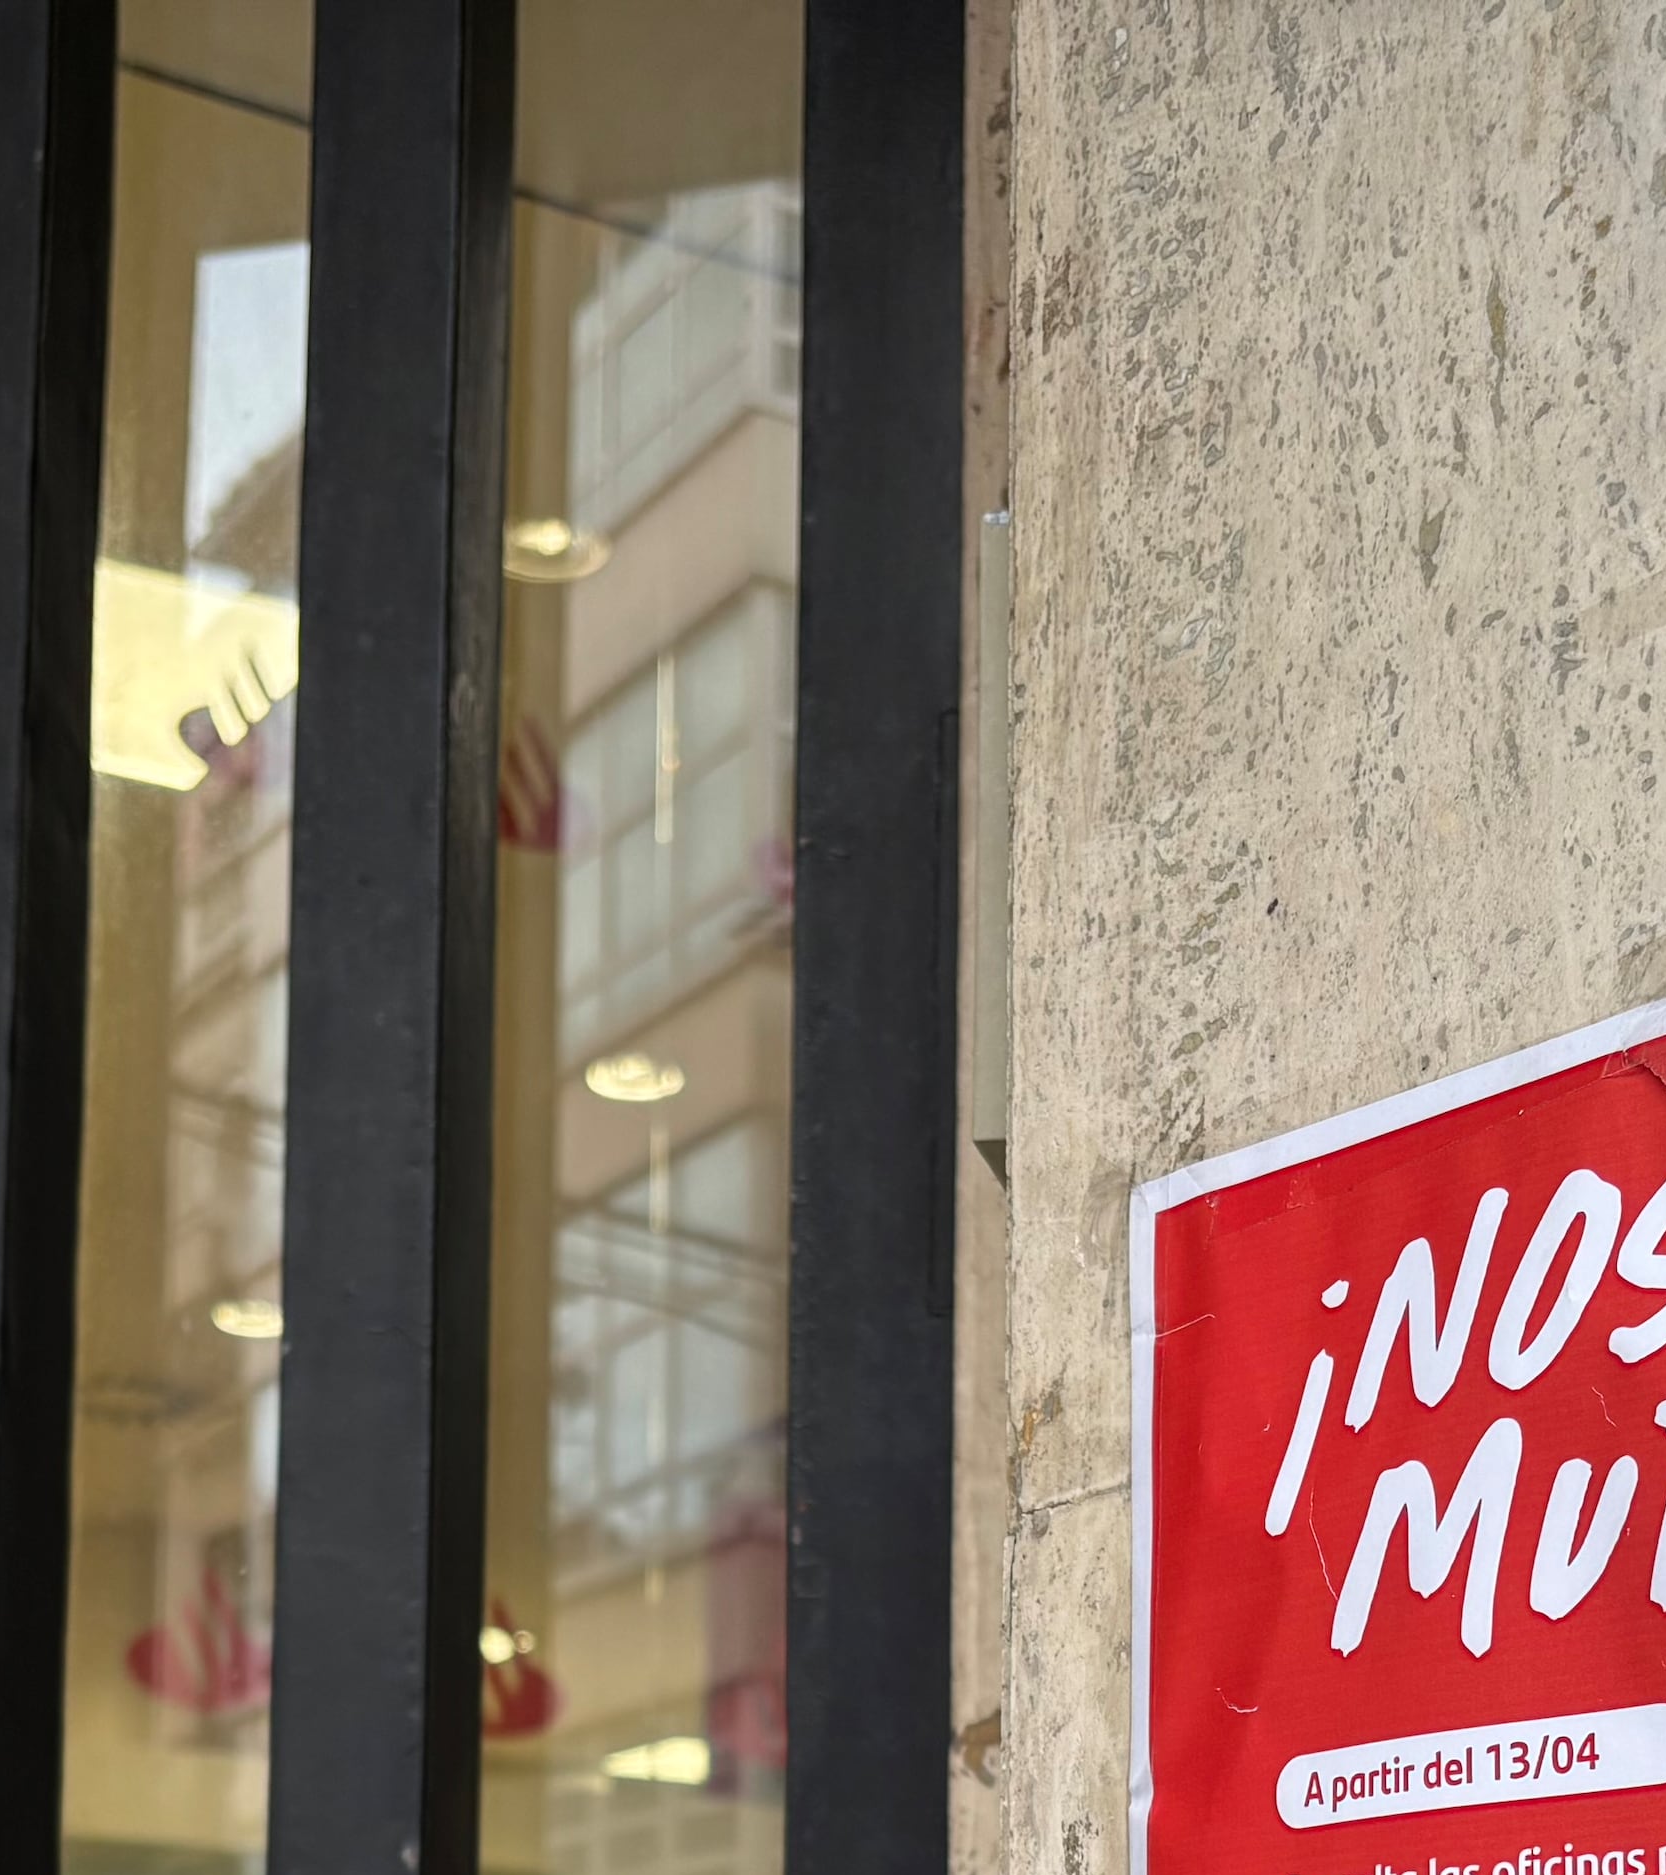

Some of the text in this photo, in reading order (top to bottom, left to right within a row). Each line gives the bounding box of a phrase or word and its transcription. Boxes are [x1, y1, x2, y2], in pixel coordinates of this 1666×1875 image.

[1304, 1732, 1600, 1813] A partir del 13/04
